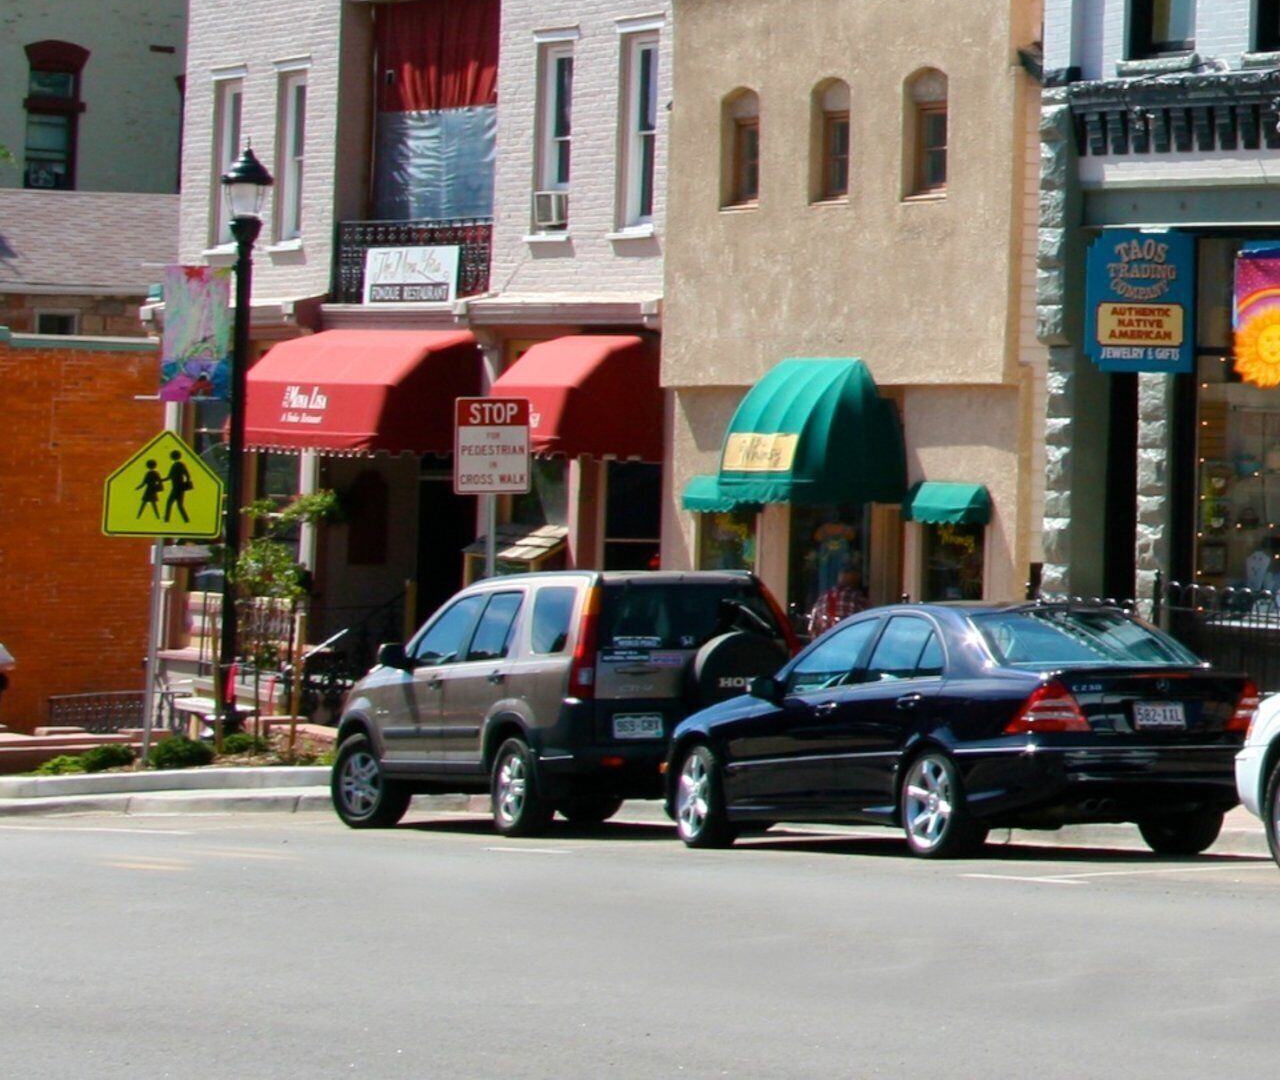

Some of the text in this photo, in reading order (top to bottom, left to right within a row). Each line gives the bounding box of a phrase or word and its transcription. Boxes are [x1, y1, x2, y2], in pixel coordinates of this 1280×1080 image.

[1114, 238, 1169, 263] TAOS
[1106, 262, 1177, 279] TRADING
[1110, 278, 1170, 300] COMPANY
[1110, 306, 1171, 318] AUTHENTIC
[1117, 319, 1164, 329] NATIVE
[1109, 329, 1172, 341] AMERICAN
[1100, 347, 1146, 360] JEWELRY
[468, 402, 519, 425] STOP
[460, 444, 526, 456] PEDESTRIAN
[460, 473, 526, 485] CROSS WALK
